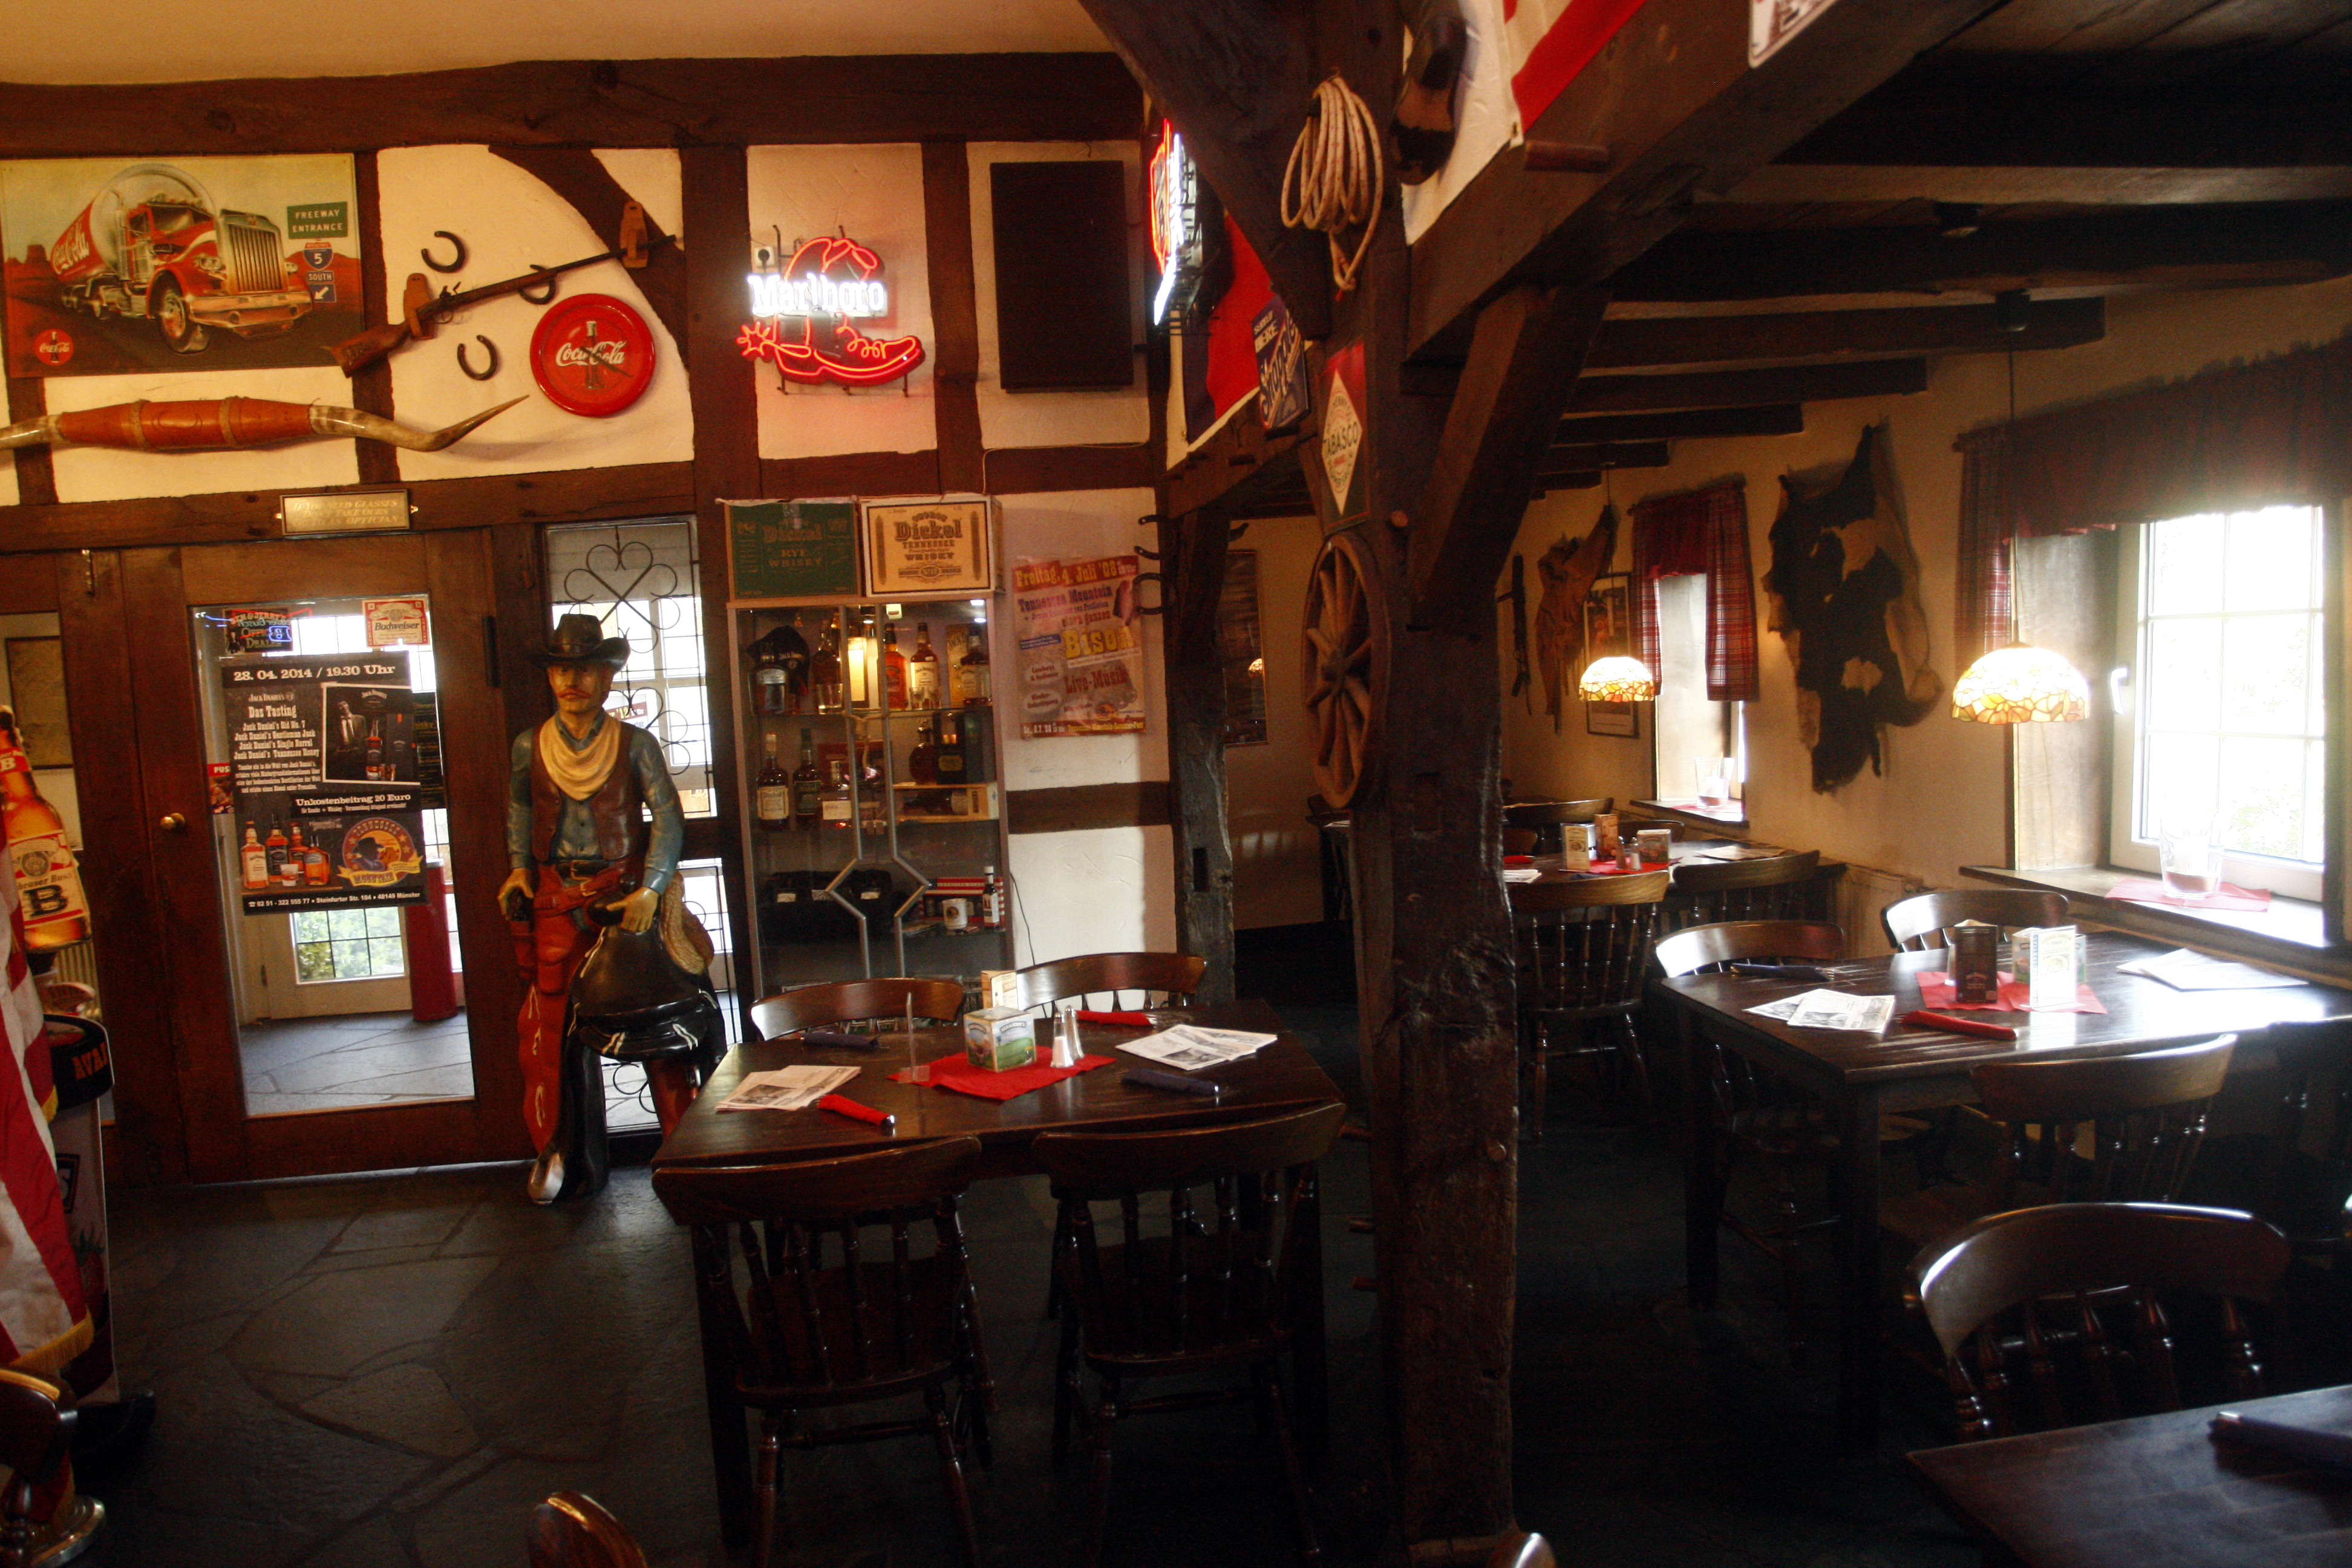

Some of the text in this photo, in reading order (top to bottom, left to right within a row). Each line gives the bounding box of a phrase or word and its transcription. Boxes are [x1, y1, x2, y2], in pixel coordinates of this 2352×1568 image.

[295, 209, 340, 219] FREEWAY
[292, 223, 343, 233] ENTRANCE
[313, 252, 323, 264] 5
[308, 272, 332, 281] SOUTH
[747, 272, 886, 313] Marlboro
[1323, 421, 1359, 457] TABASCO
[354, 499, 398, 508] GLASSES
[346, 515, 400, 524] OPTICIAN
[893, 518, 962, 541] Dickel
[780, 548, 809, 558] RYE
[905, 552, 954, 561] WHISKY
[768, 557, 823, 567] WHISKY
[1062, 569, 1073, 585] 4.
[1076, 564, 1098, 583] Juli
[1068, 584, 1112, 604] Mountain
[375, 621, 420, 630] Budweiser
[1062, 626, 1135, 659] Bison
[234, 664, 396, 681] 28. 04. 2014 / 19.30 Uhr
[248, 705, 298, 718] Das Tasting
[243, 720, 305, 731] Jack Daniel's Old No. 7
[234, 729, 316, 741] Jack Daniel's Gentleman Jack
[239, 738, 313, 750] Jack Daniel's Single Barrel
[234, 748, 320, 760] Jack Daniel's Tennessee Honey
[295, 795, 373, 806] Unkostenbeitrag
[18, 878, 48, 890] heuser
[24, 885, 68, 916] B
[316, 895, 348, 904] Steinfurter
[396, 891, 420, 900] Münster
